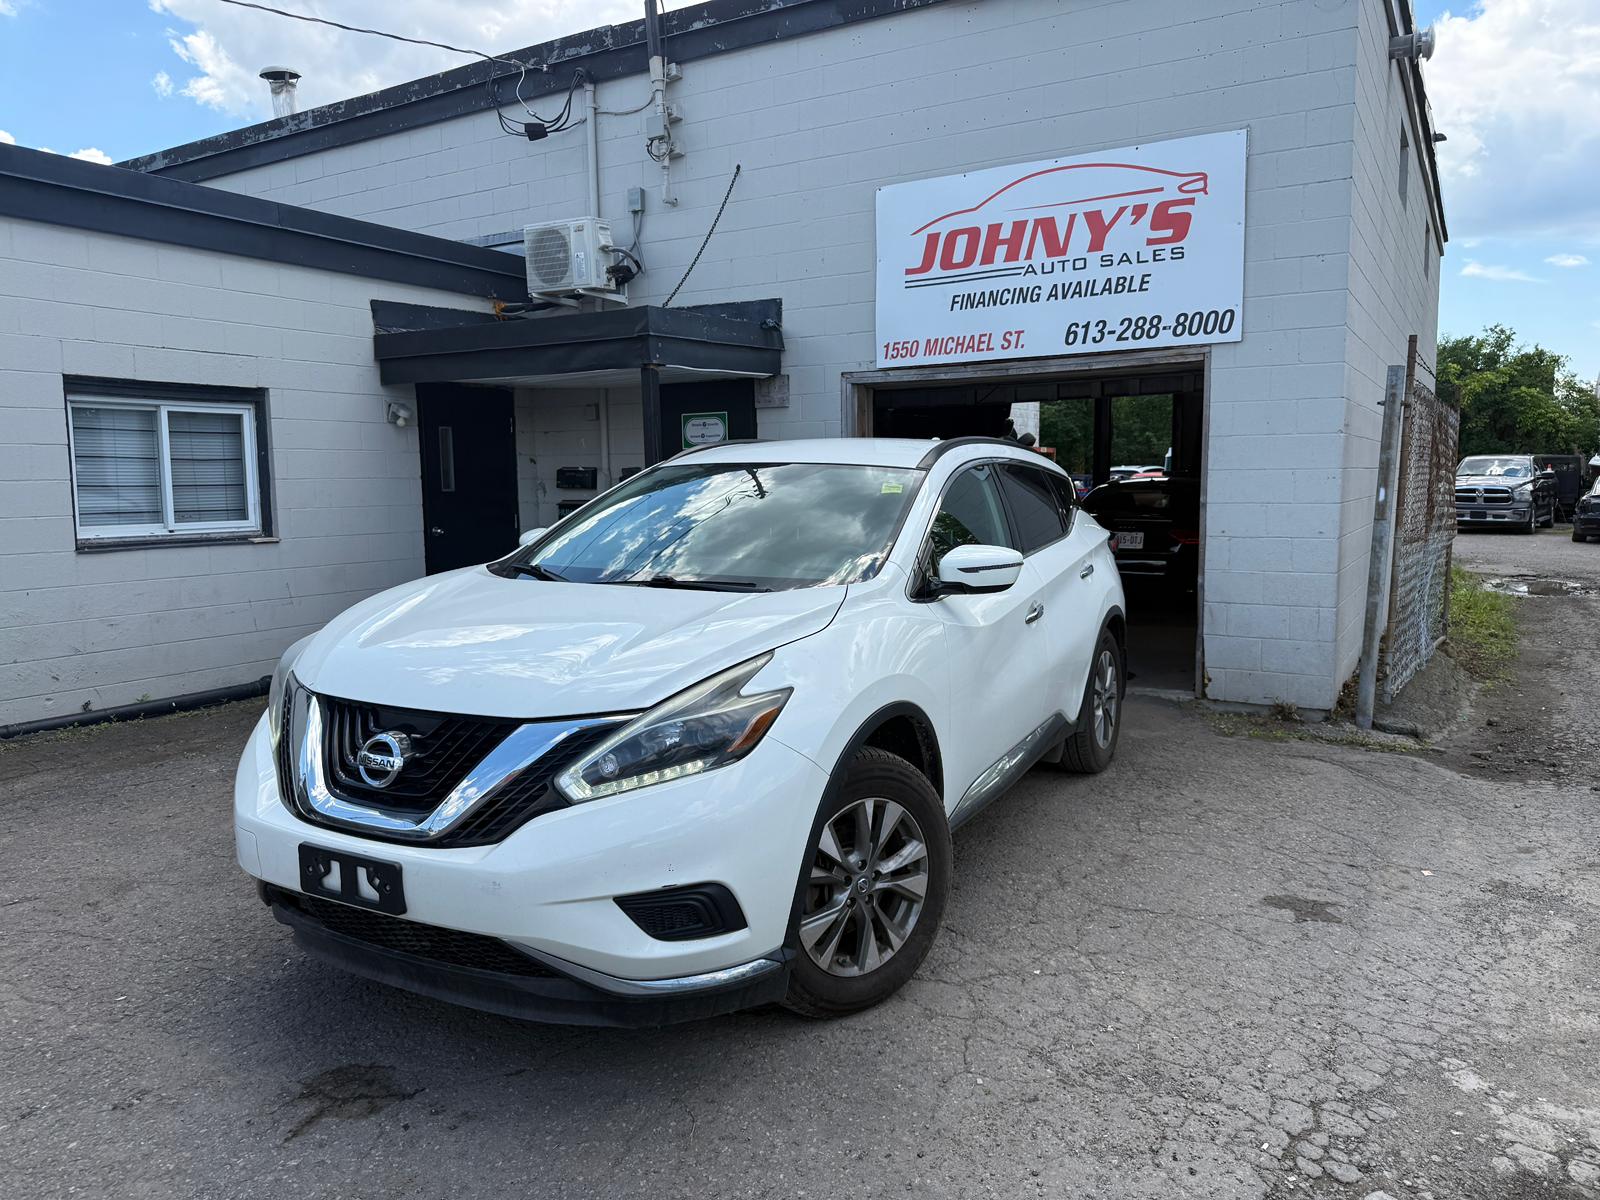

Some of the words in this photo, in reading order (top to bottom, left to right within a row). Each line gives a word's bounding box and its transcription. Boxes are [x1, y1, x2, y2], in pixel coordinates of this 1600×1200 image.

[904, 197, 1196, 276] JOHNY'S
[1022, 257, 1087, 276] AUTO
[1100, 247, 1185, 268] SALES
[950, 285, 1042, 312] FINANCING
[1046, 274, 1152, 301] AVAILABLE
[1064, 308, 1236, 346] 613-288-8000
[883, 340, 920, 360] 1550
[923, 333, 995, 357] MICHAEL
[1001, 330, 1025, 350] ST.
[359, 754, 395, 769] NISSAN
